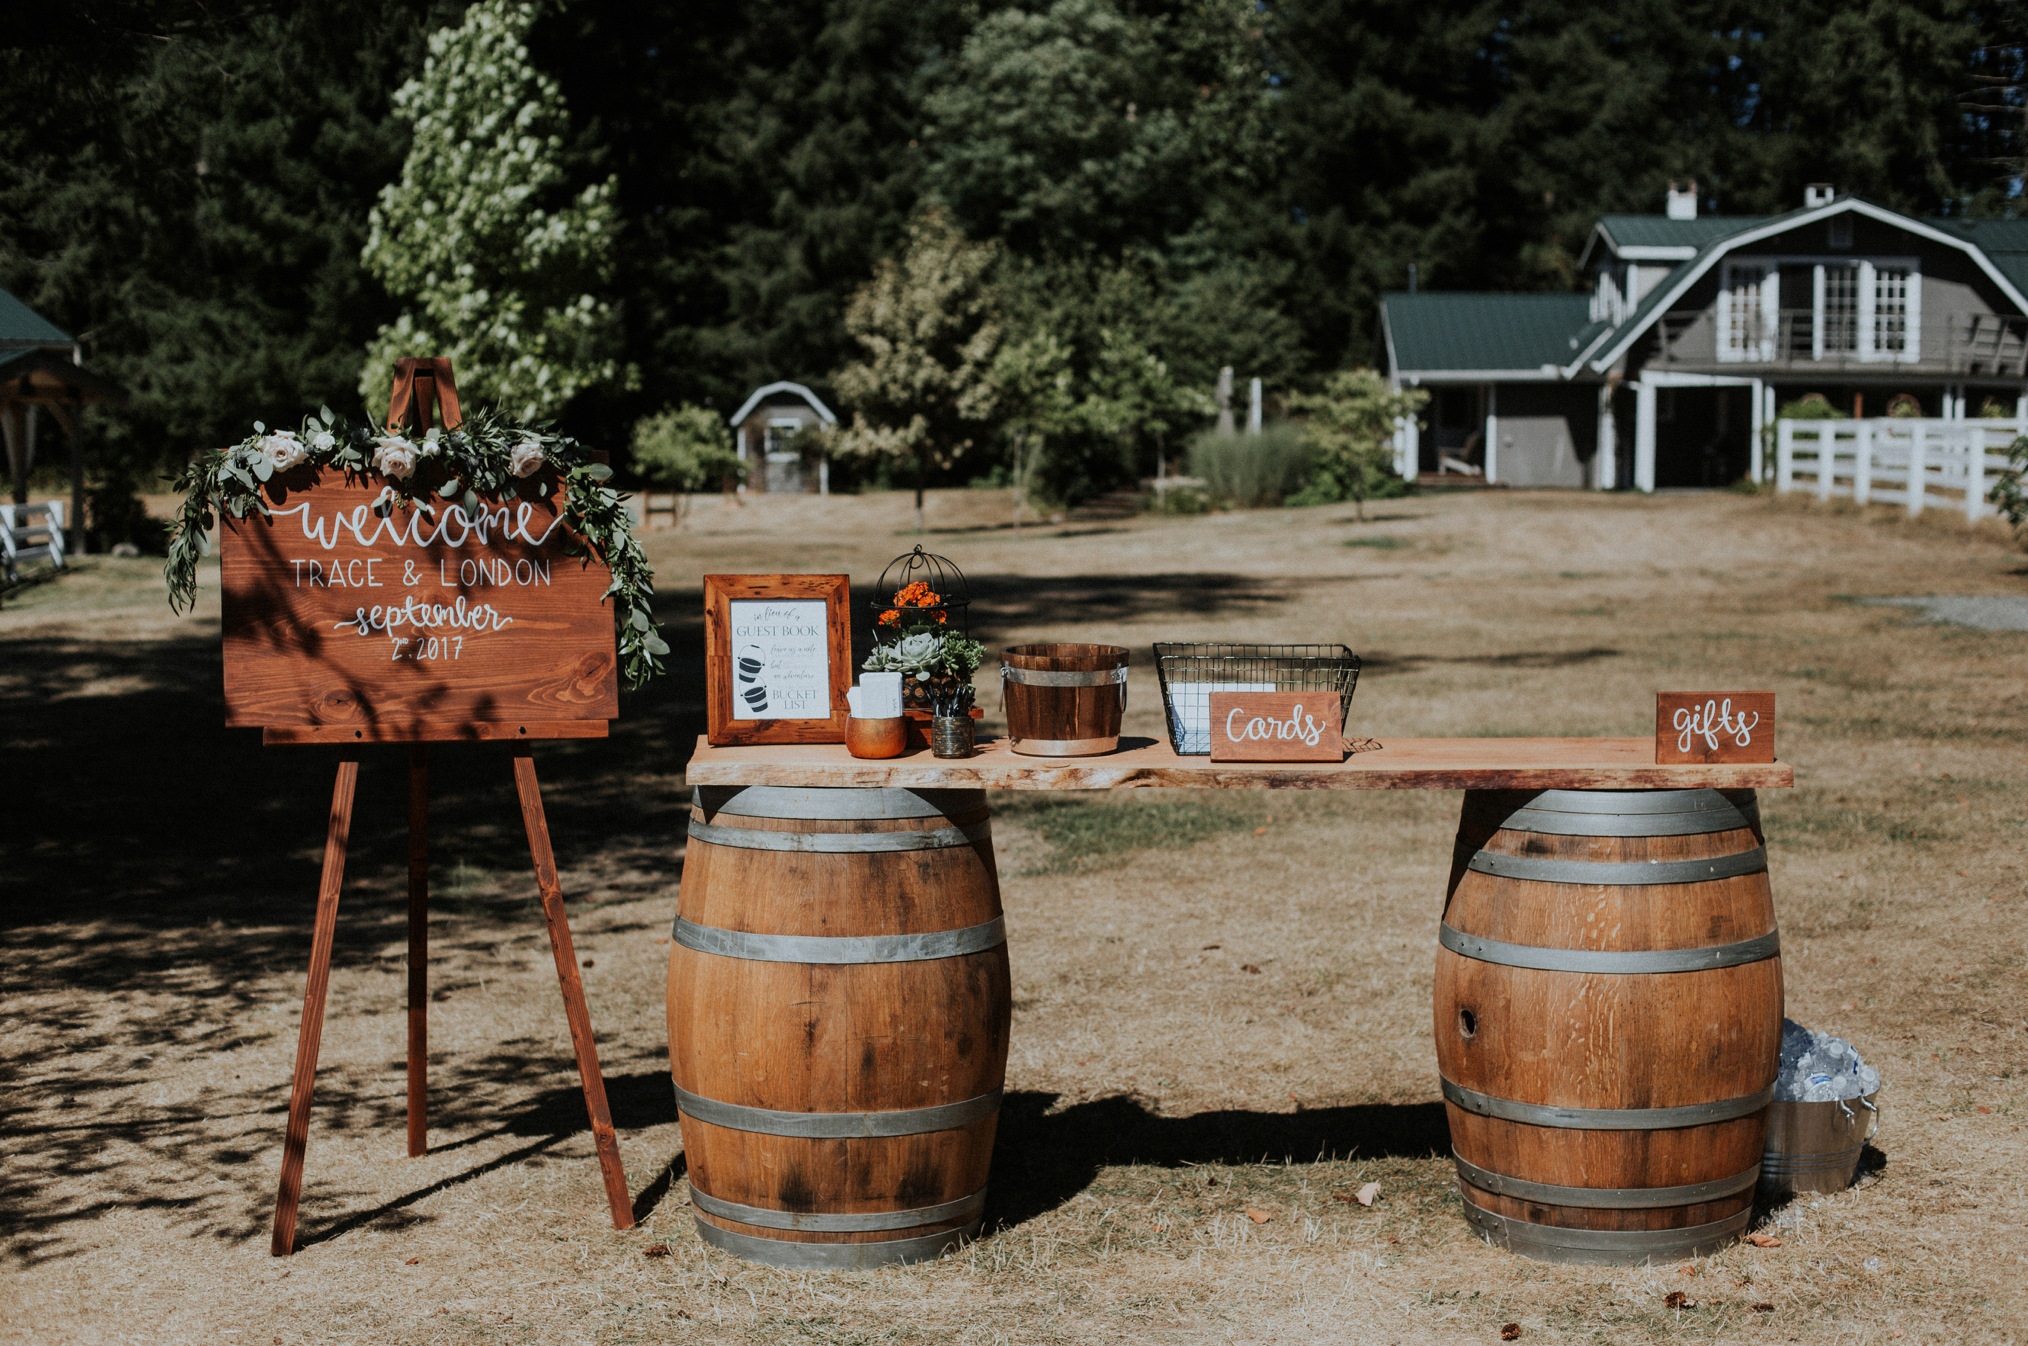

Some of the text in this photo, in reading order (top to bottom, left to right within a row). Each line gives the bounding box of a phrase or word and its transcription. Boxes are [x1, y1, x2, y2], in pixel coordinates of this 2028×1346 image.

[268, 485, 566, 550] welcome
[289, 557, 551, 588] TRACE & LONDON
[333, 595, 513, 637] september
[736, 625, 819, 637] GUEST BOOK
[416, 636, 463, 660] 2017
[772, 689, 818, 700] BUCKET
[784, 699, 808, 710] LIST
[1225, 704, 1327, 747] Cards
[1673, 698, 1759, 753] gifts
